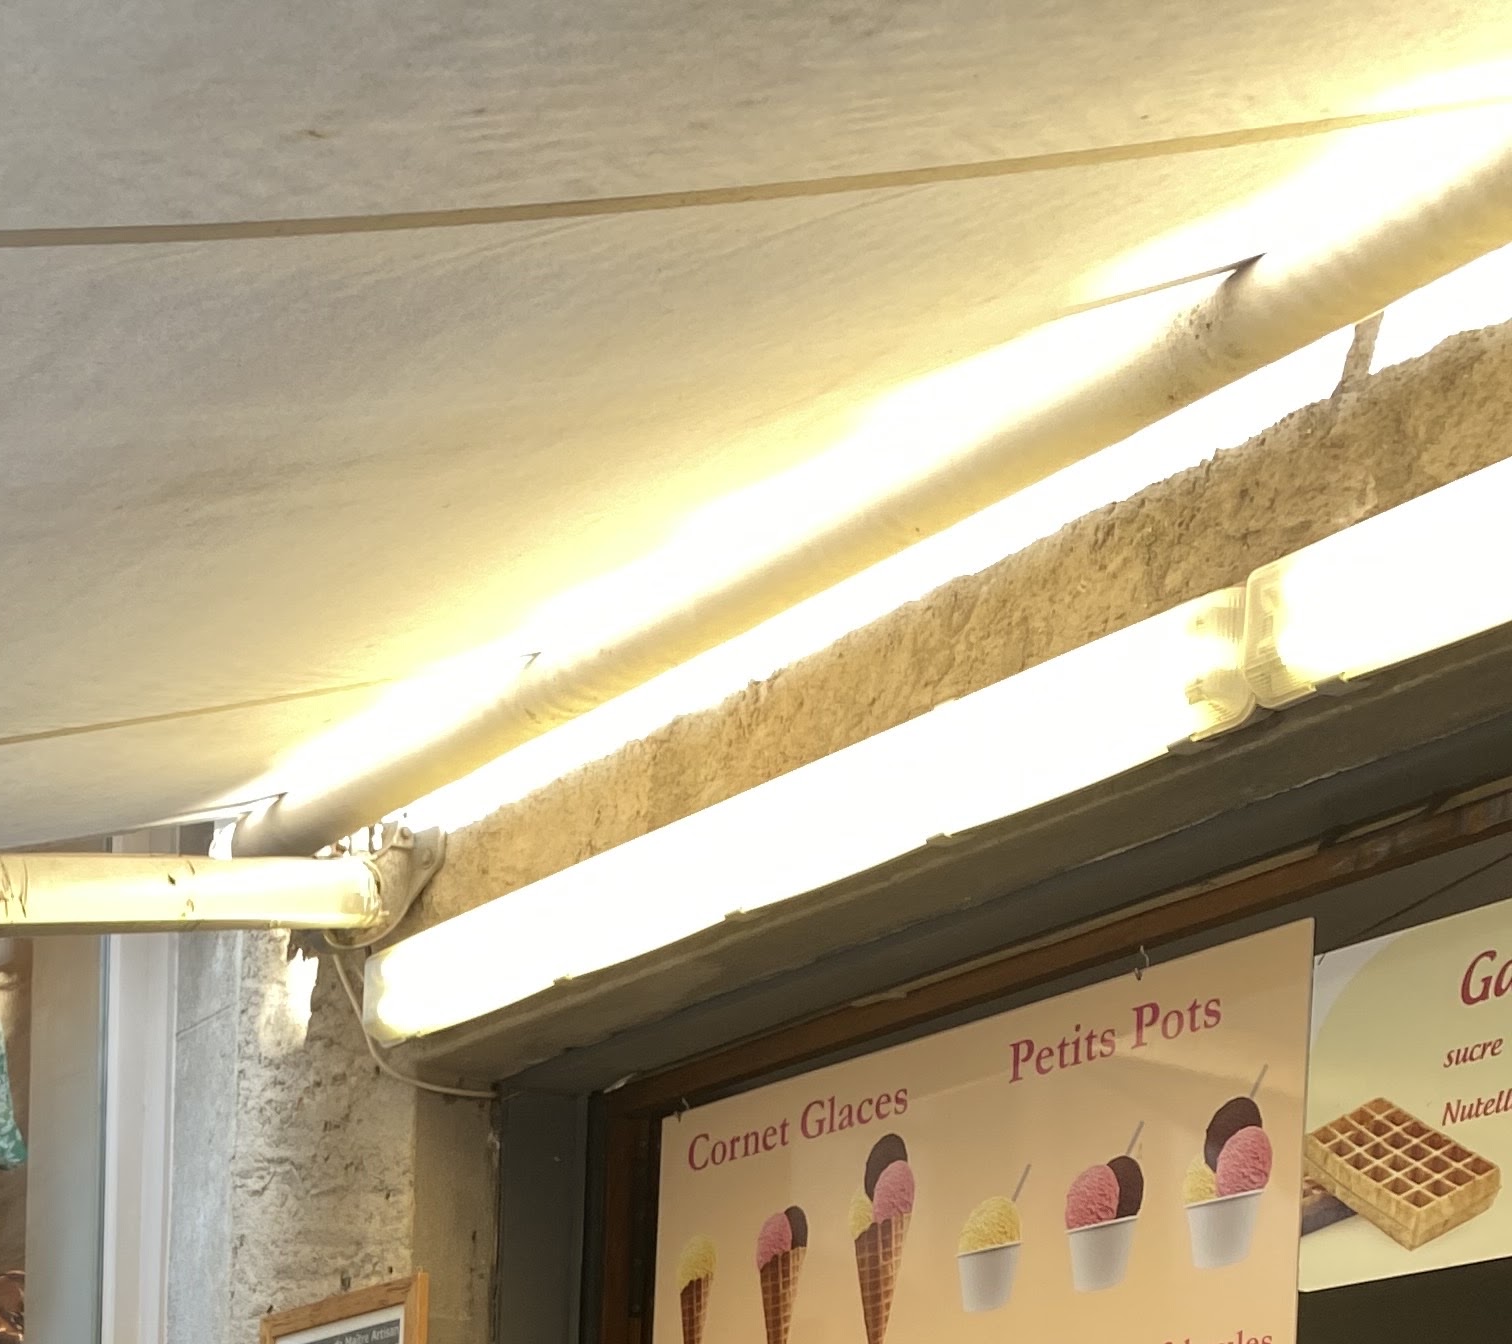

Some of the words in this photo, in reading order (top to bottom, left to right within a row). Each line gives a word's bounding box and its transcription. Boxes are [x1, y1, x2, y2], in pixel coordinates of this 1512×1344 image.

[1009, 1023, 1117, 1084] Petits
[1131, 998, 1222, 1050] Pots
[1443, 1038, 1504, 1069] sucre
[688, 1118, 791, 1172] Cornet
[800, 1087, 909, 1140] Glaces
[1442, 1087, 1512, 1127] Nutell
